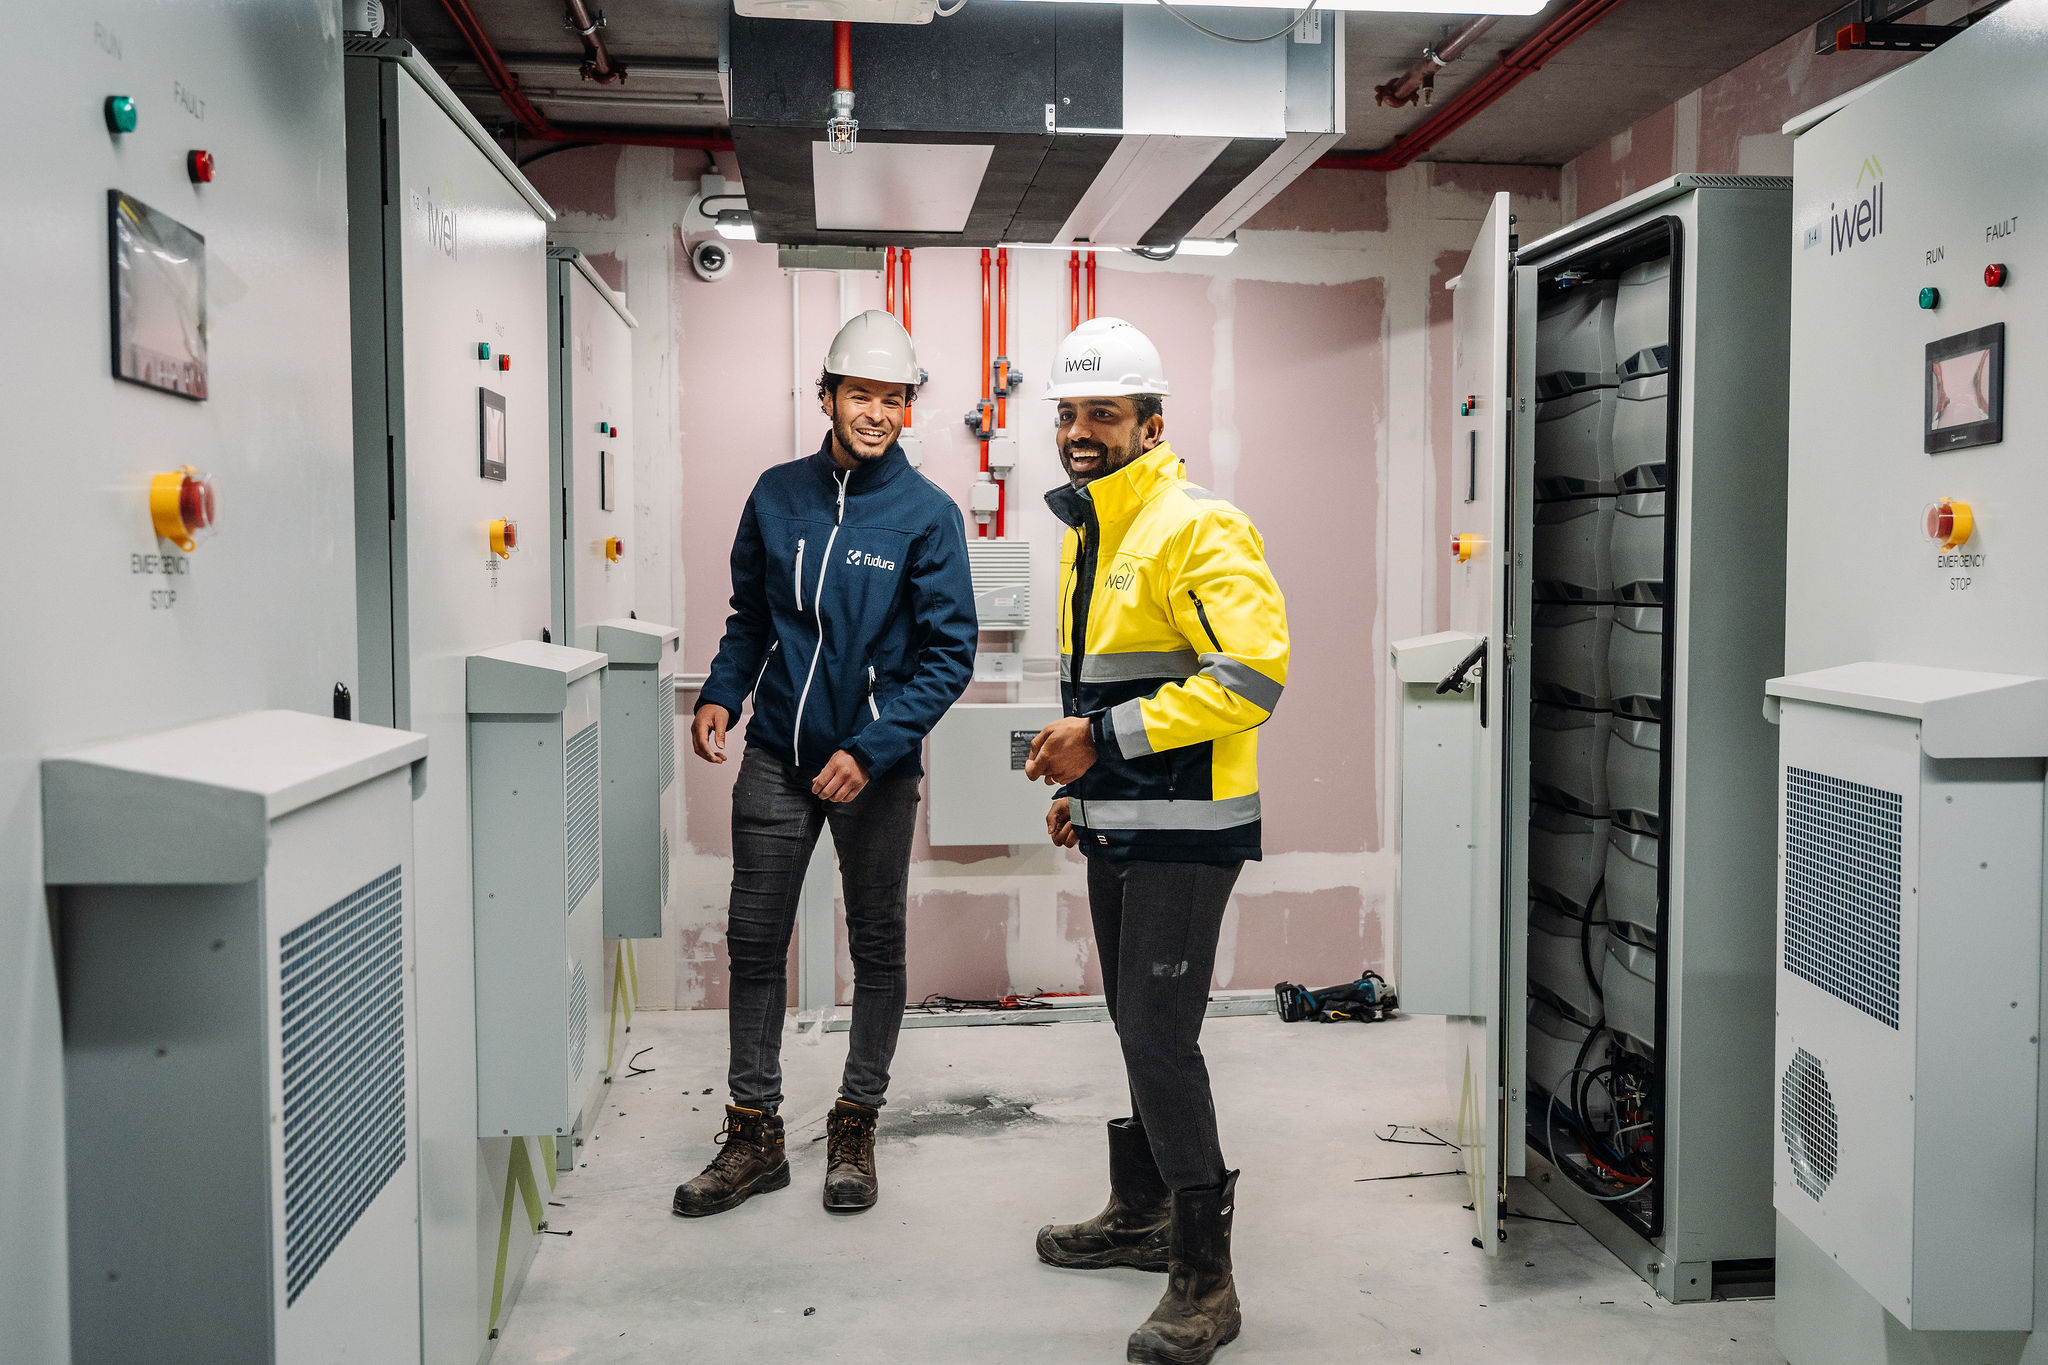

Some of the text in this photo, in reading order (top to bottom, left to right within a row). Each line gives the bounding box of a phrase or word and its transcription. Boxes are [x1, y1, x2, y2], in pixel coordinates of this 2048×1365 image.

[174, 80, 206, 121] FAULT
[427, 185, 458, 262] iwell
[1830, 181, 1883, 256] iwell
[1985, 216, 2018, 243] FAULT
[1925, 245, 1944, 266] RUN
[1065, 356, 1101, 373] iwell
[863, 553, 895, 571] fudura
[1937, 554, 1986, 568] EMERGENCY
[1104, 573, 1135, 591] well
[1950, 577, 1971, 591] STOP
[151, 589, 177, 610] STOP
